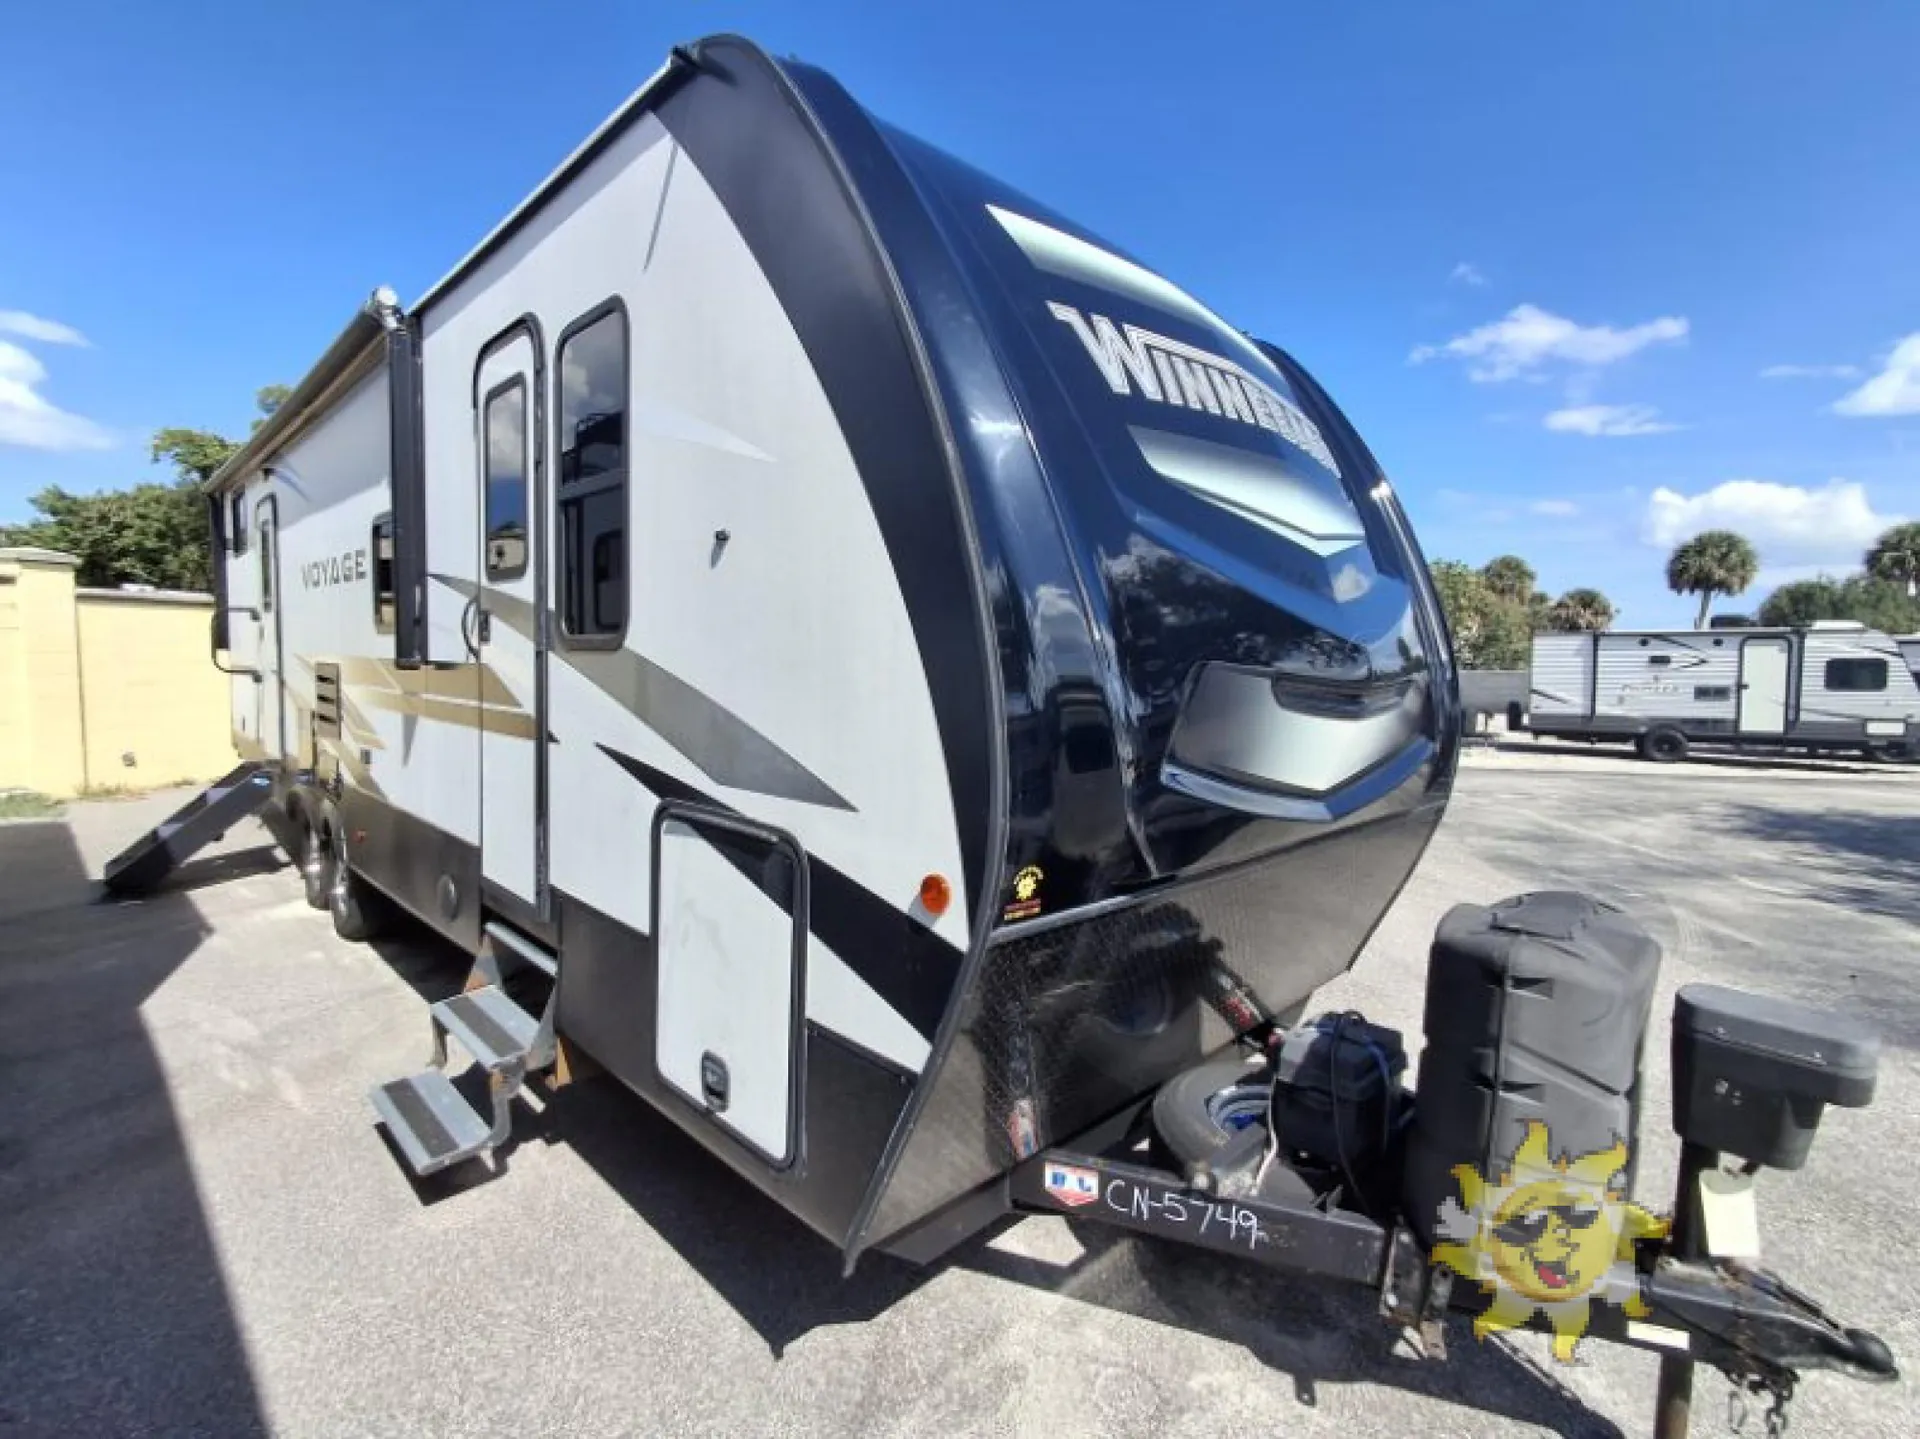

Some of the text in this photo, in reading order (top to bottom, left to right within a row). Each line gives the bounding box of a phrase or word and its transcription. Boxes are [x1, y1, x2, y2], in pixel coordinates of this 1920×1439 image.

[1046, 299, 1343, 479] WINNE
[301, 549, 367, 592] VOYAGE
[1105, 1179, 1261, 1249] CN-5749
